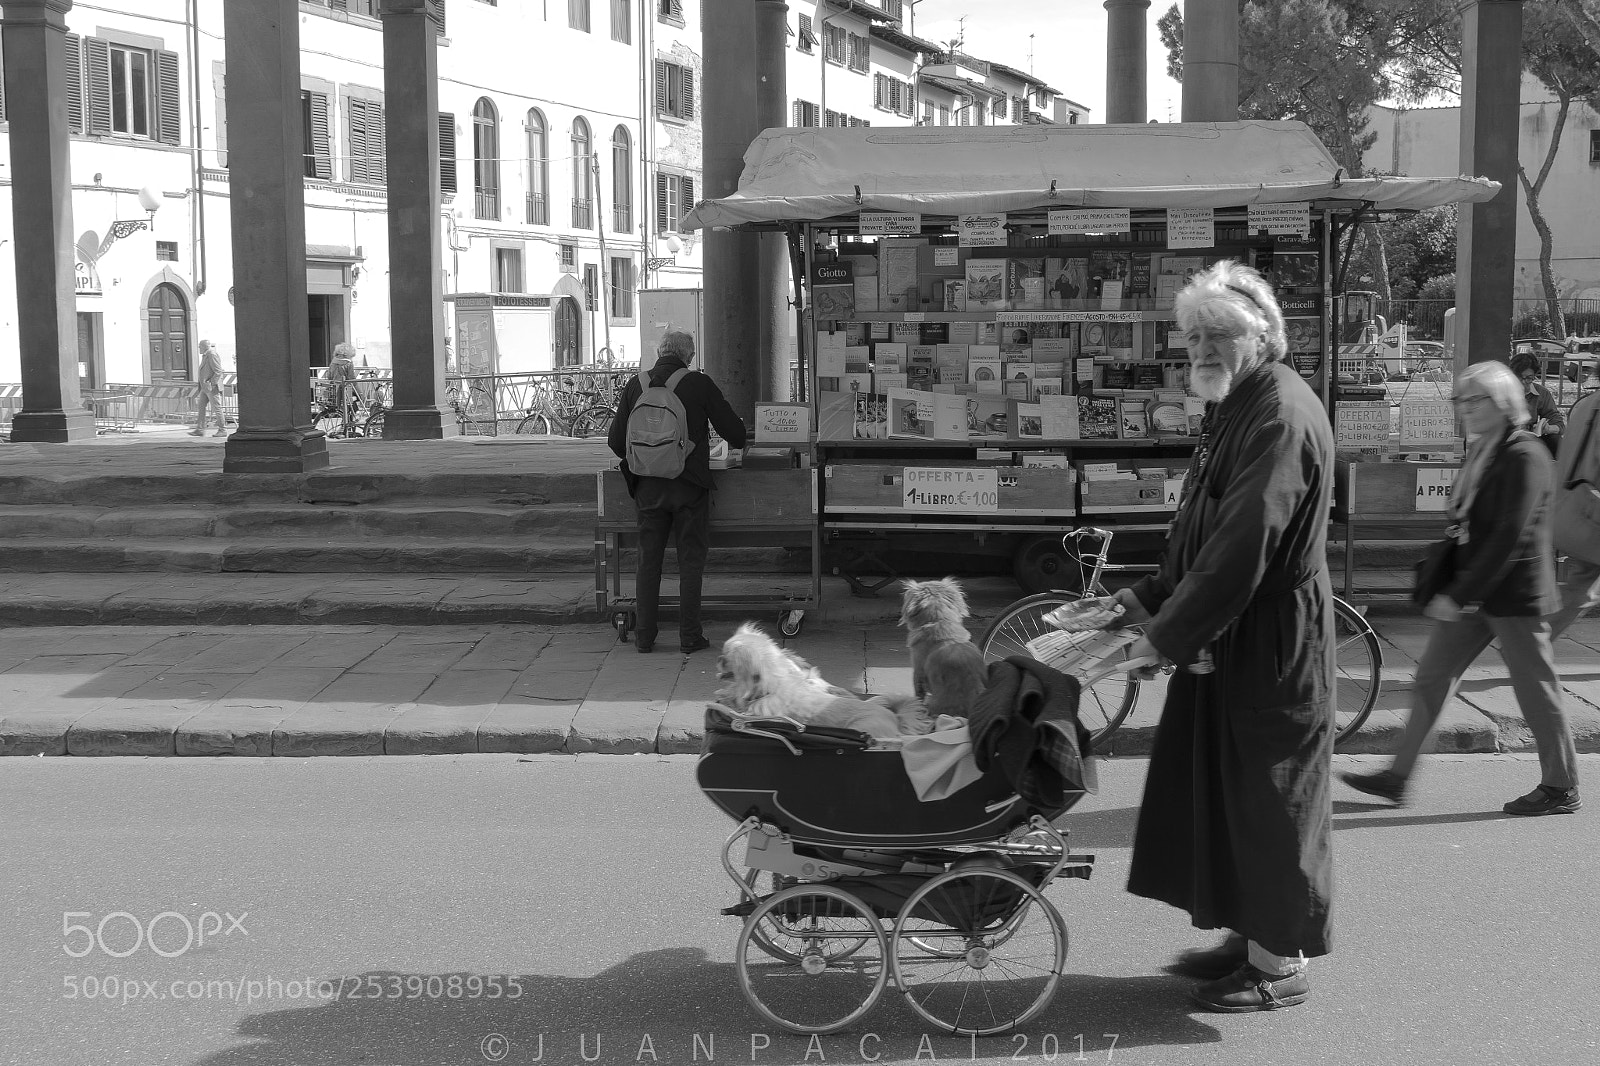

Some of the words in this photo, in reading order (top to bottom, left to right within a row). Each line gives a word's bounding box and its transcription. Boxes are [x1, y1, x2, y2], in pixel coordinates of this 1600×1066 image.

[818, 267, 847, 278] Giotto
[497, 297, 548, 306] FOTOTESSERA
[1281, 300, 1315, 309] Botticelli
[1405, 405, 1450, 415] OFFERTA
[1340, 411, 1383, 420] OFFERTA
[908, 471, 974, 482] OFFERTA
[1417, 486, 1424, 496] A
[1429, 486, 1453, 496] PRE
[1168, 492, 1176, 502] A
